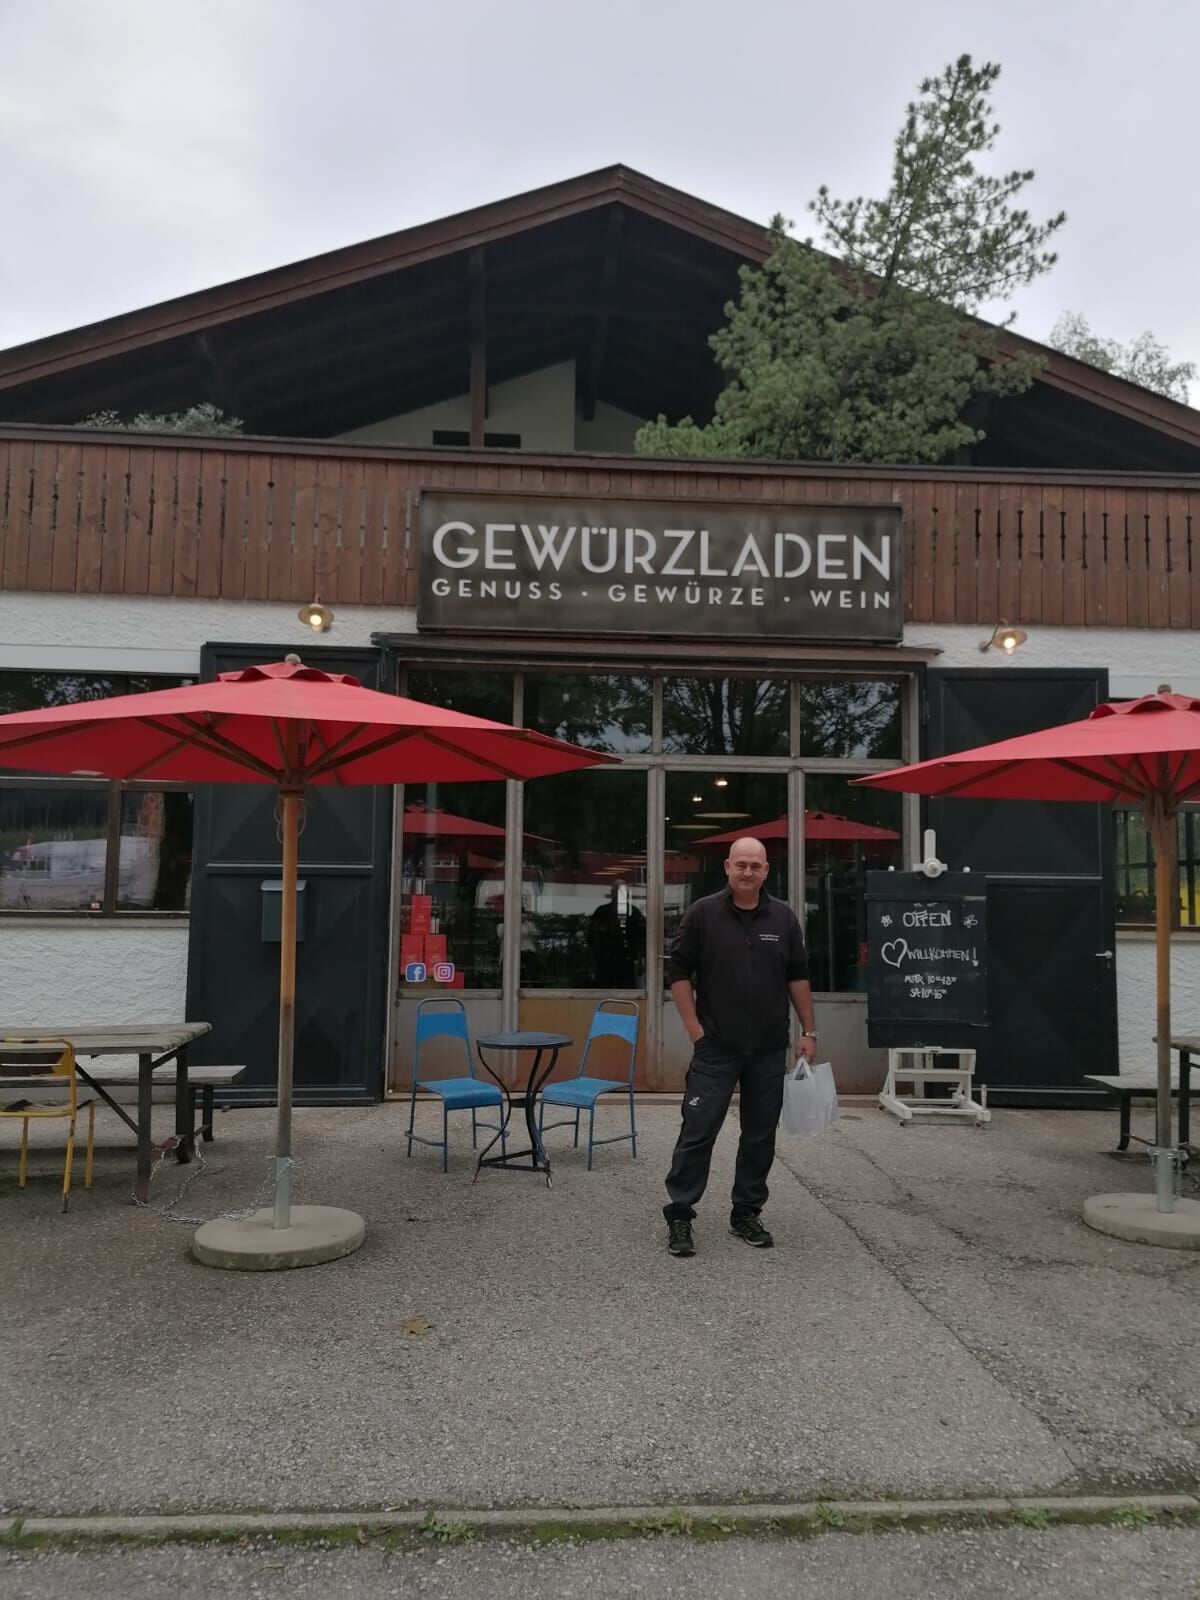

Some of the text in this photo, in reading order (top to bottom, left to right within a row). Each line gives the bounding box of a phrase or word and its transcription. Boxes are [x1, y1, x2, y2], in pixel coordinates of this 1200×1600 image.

[432, 521, 891, 581] GEWÜRZLADEN
[432, 578, 890, 609] GENUSS GEWÜRZE WEIN
[903, 910, 952, 927] OFFEN
